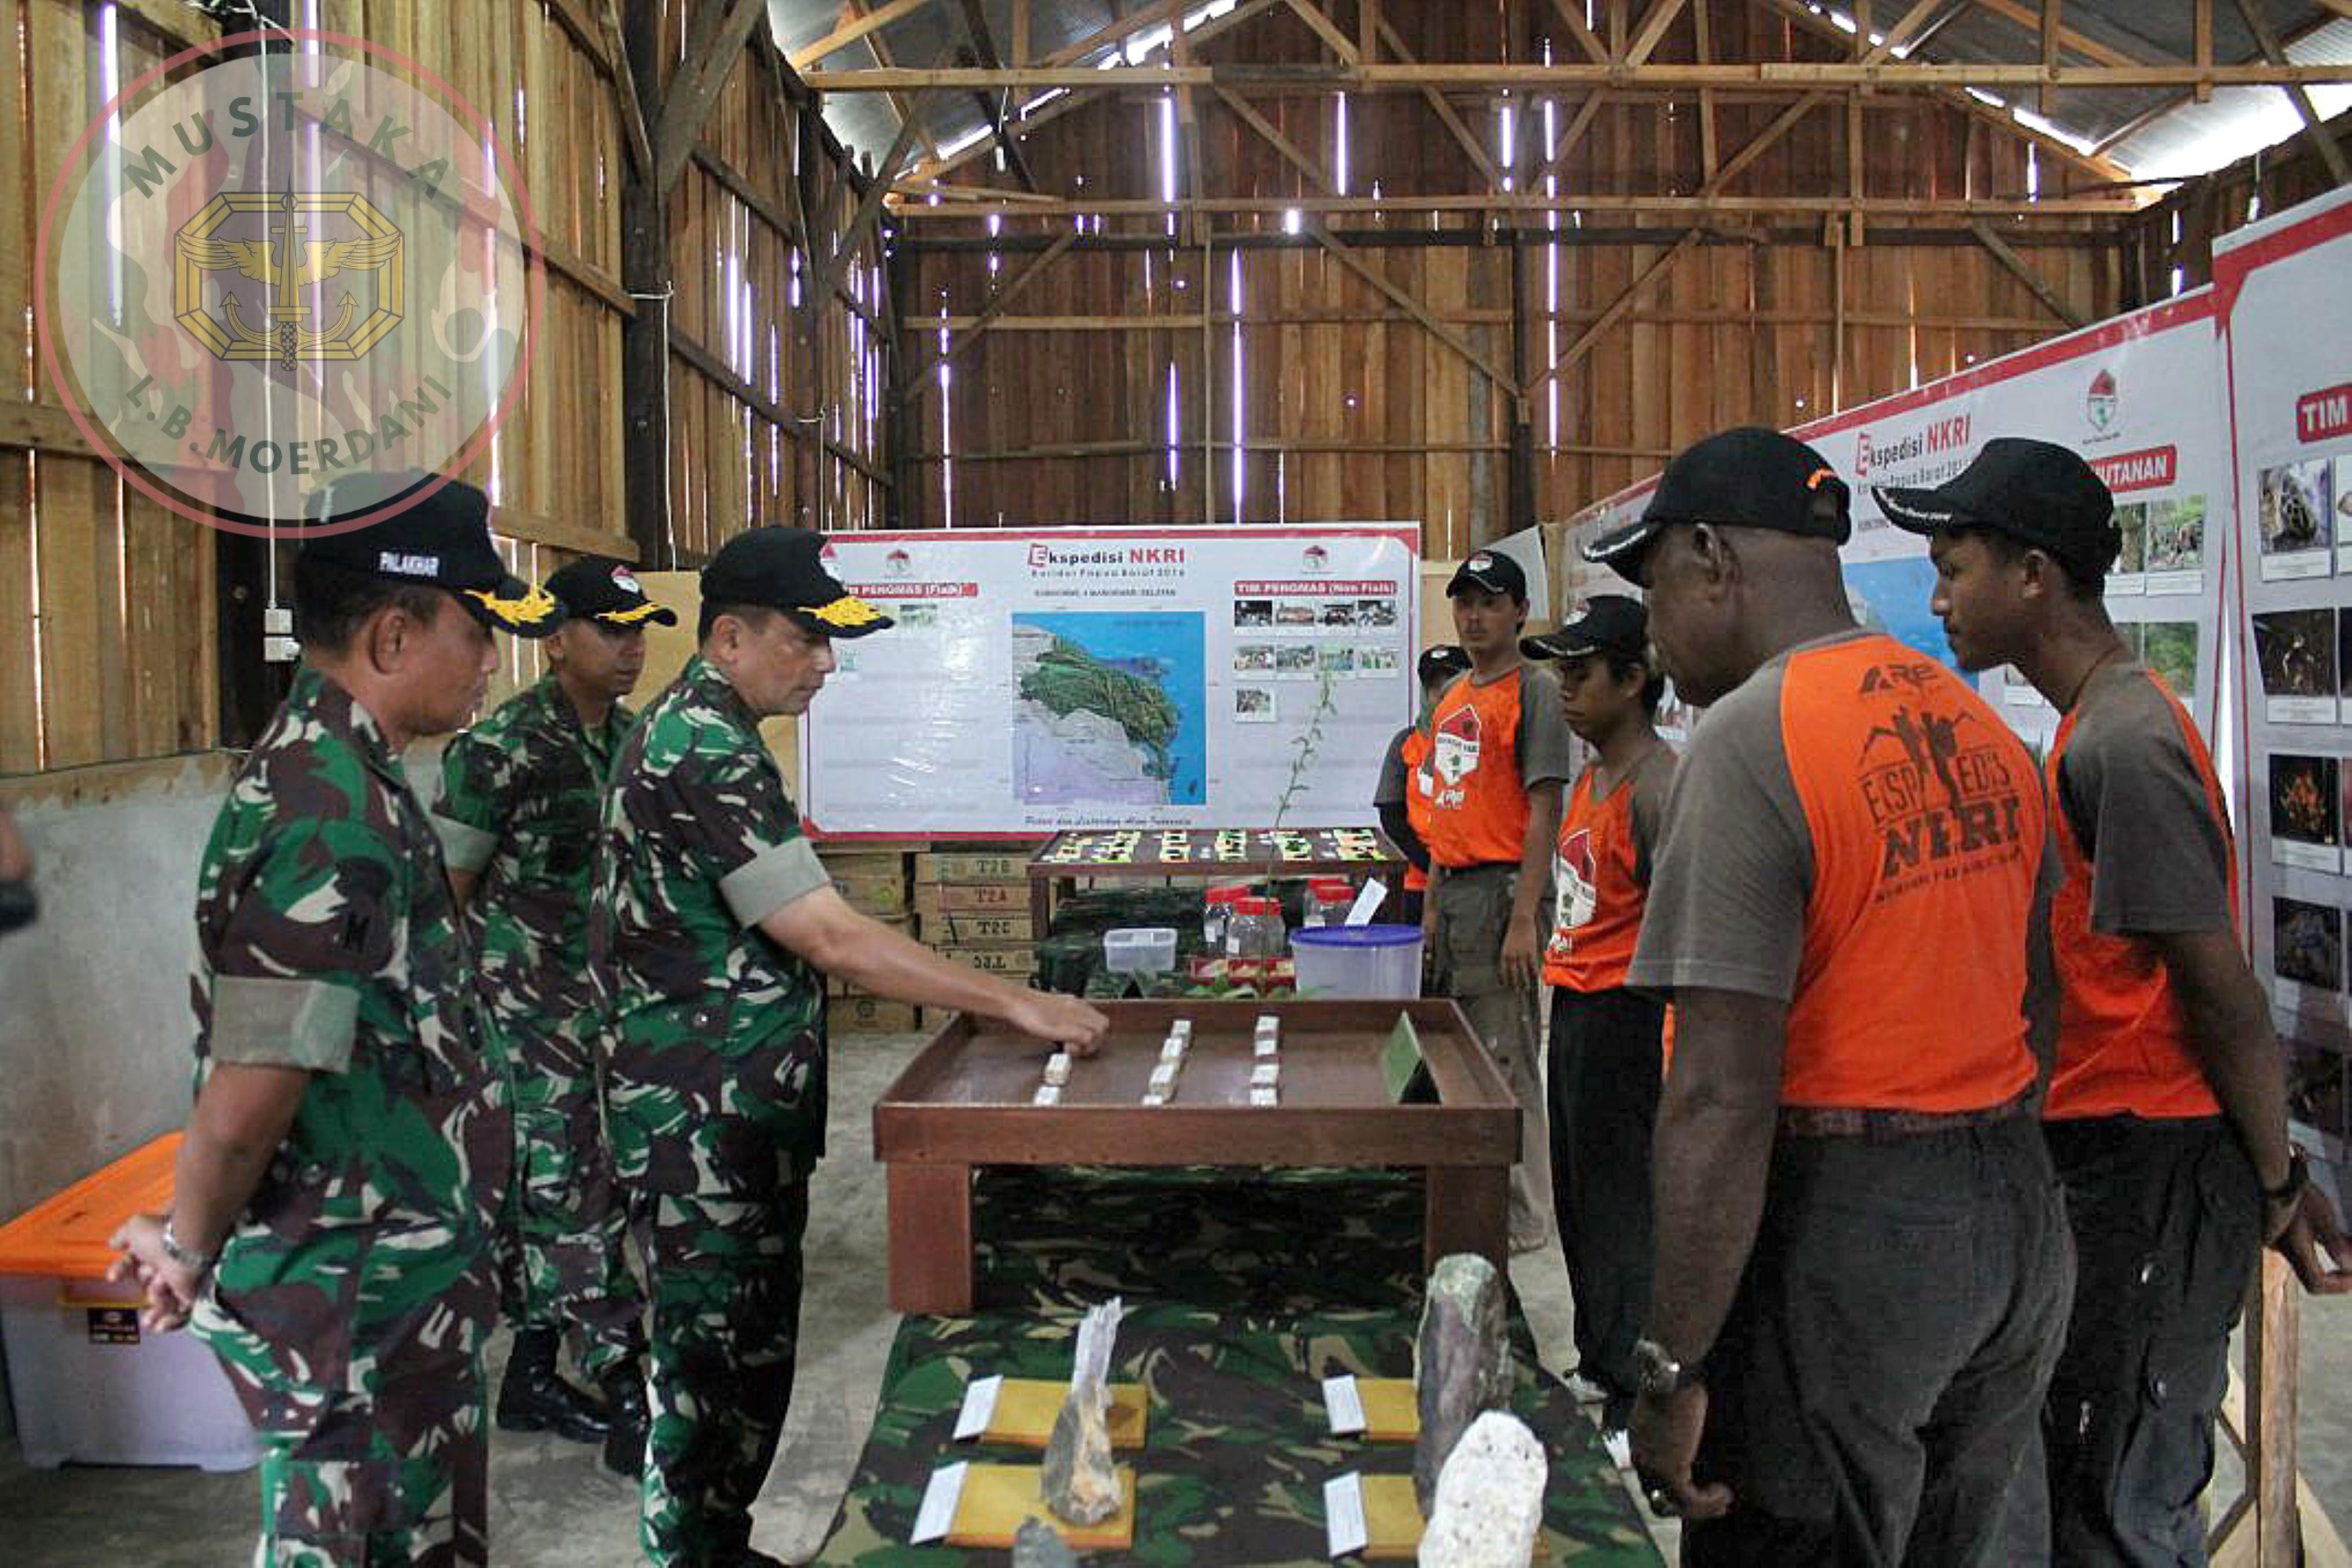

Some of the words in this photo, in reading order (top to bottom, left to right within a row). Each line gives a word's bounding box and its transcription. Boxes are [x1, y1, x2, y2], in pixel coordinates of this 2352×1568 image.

[2302, 395, 2346, 432] TIM
[1856, 431, 1923, 476] Ekspedisi
[1928, 413, 1971, 454] NKRI
[1027, 543, 1123, 567] Ekspedisi
[1130, 549, 1185, 564] NKRI
